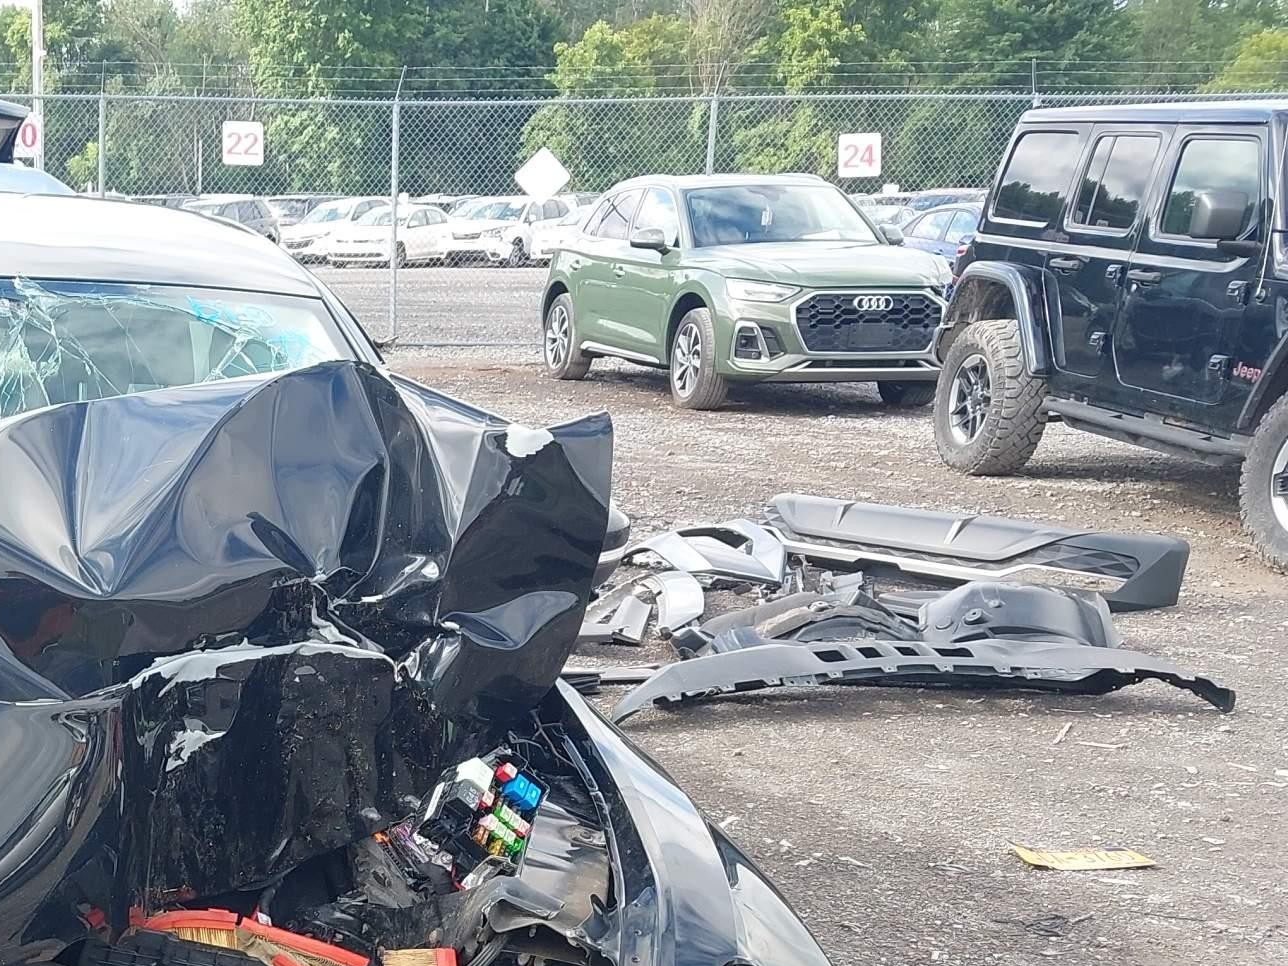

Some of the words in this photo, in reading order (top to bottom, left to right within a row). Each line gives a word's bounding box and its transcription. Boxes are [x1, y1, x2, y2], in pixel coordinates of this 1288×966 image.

[227, 132, 259, 156] 22
[843, 143, 876, 168] 24
[1232, 361, 1262, 383] Jeep
